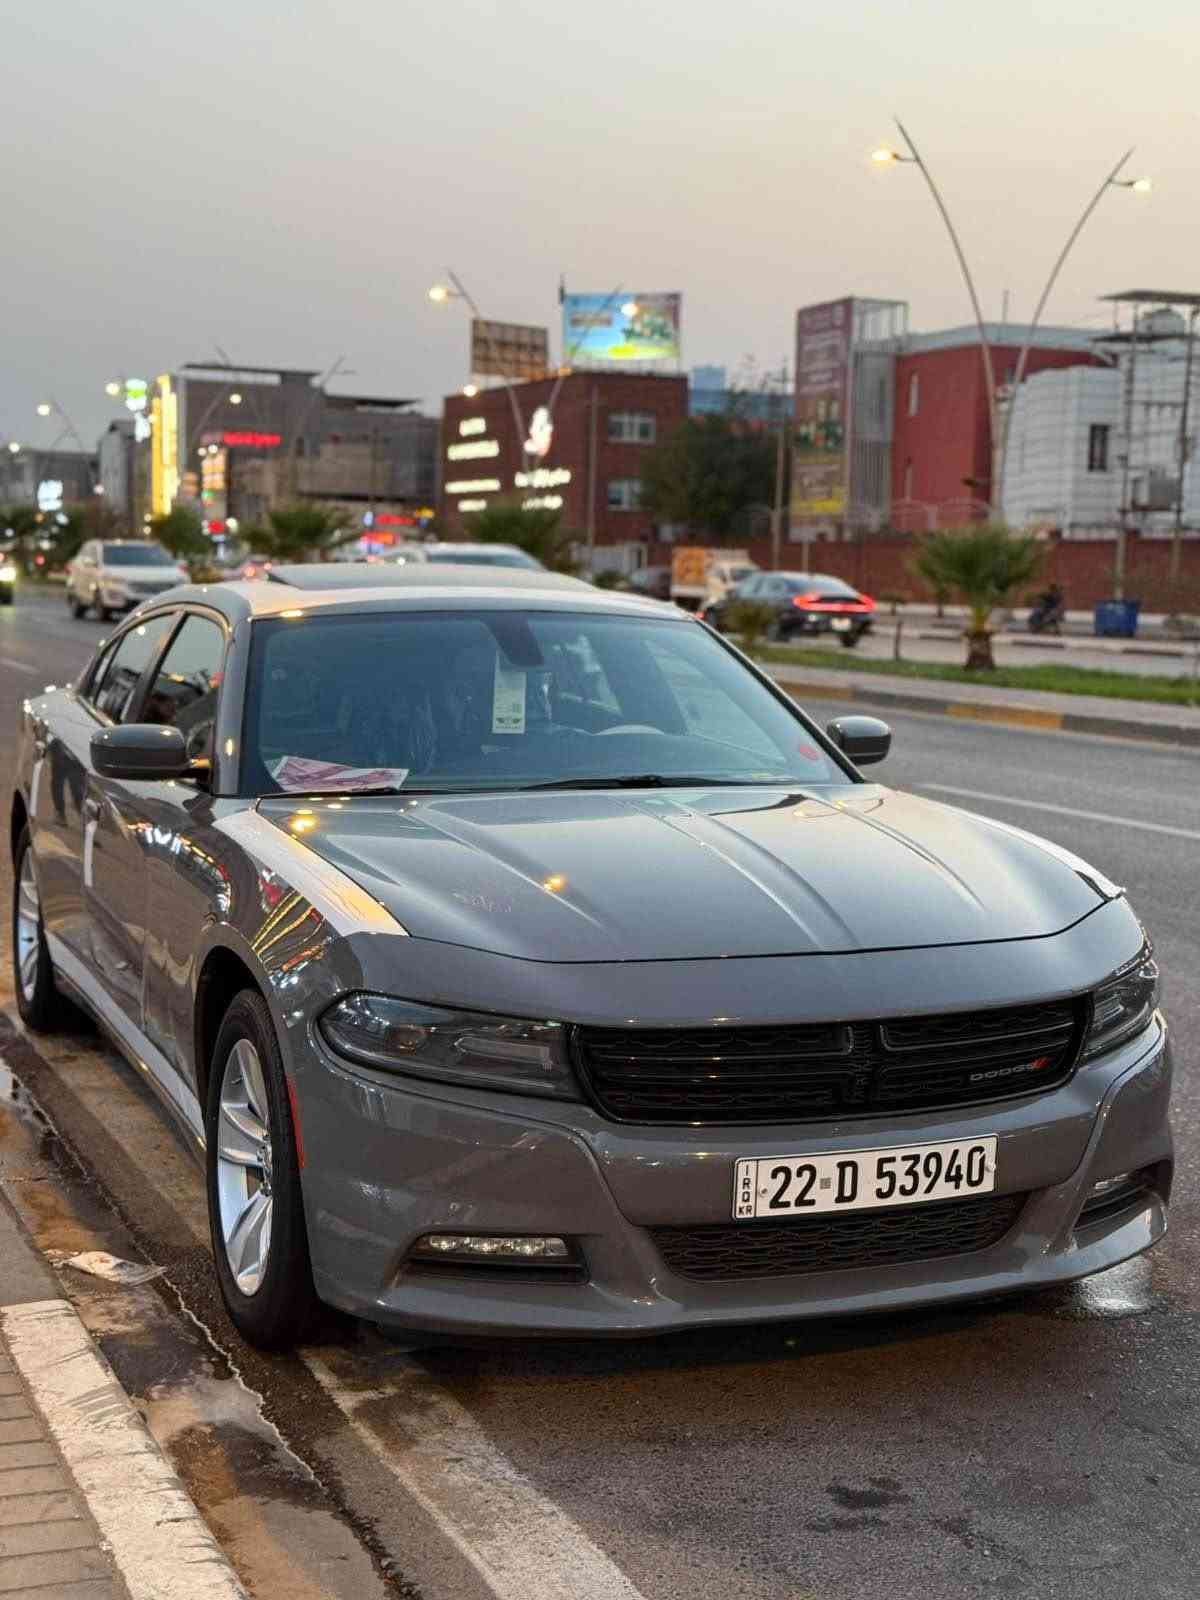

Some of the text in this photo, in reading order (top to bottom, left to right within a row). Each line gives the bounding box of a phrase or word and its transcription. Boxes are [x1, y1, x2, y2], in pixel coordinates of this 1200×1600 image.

[769, 1146, 986, 1209] 22 D 53940
